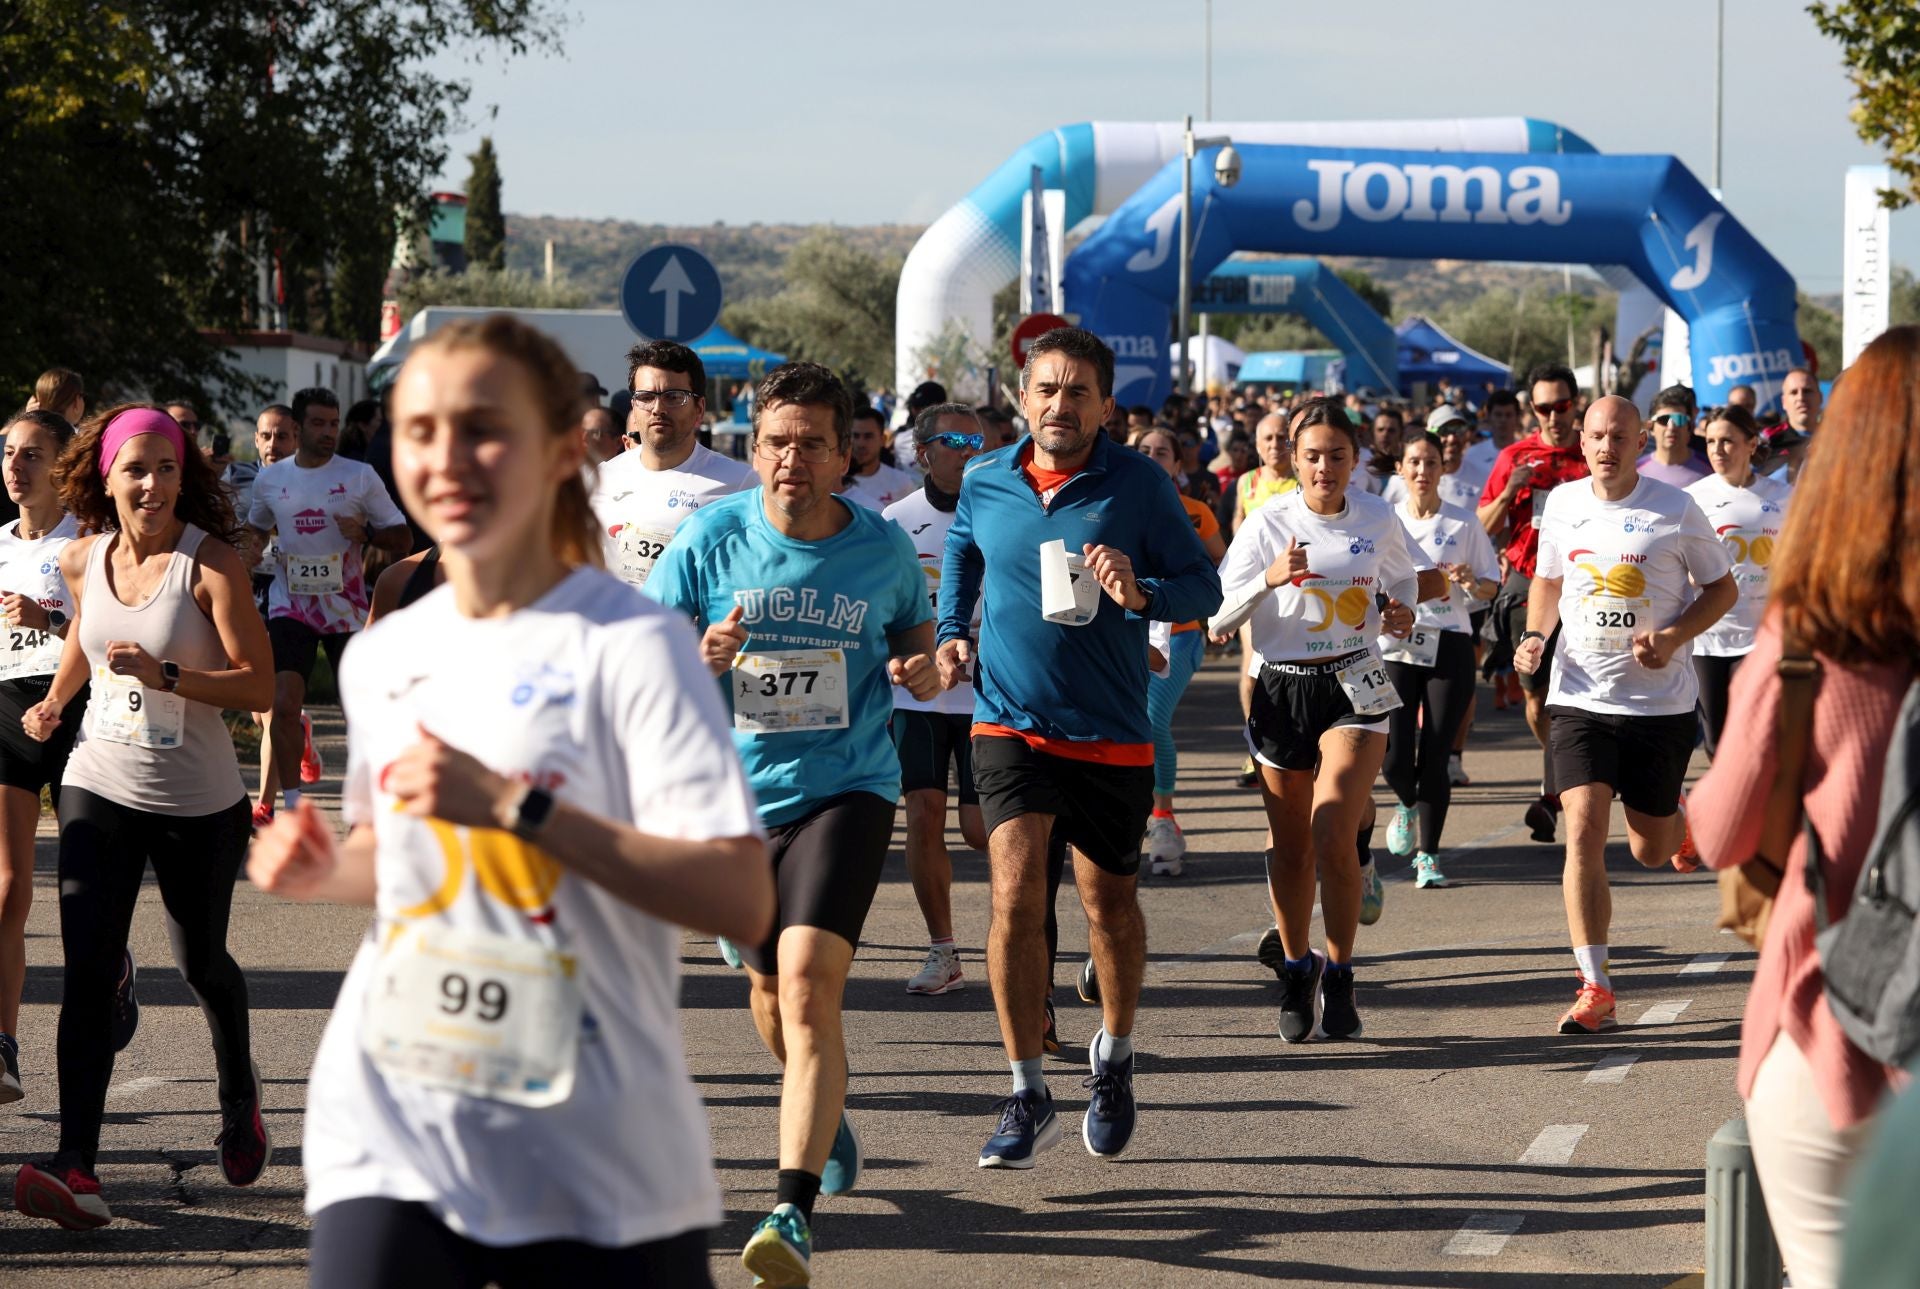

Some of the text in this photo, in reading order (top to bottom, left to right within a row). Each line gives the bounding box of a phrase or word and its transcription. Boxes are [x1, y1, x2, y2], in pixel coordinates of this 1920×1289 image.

[1620, 553, 1647, 563] HNP
[300, 565, 330, 578] 213
[1352, 576, 1373, 586] HNP
[733, 587, 868, 635] UCLM
[1596, 611, 1636, 628] 320
[750, 632, 860, 650] ORTE UNIVERSITARIO
[1305, 641, 1333, 652] 1974
[1343, 636, 1364, 649] 2024
[1269, 663, 1318, 676] MOUR
[760, 671, 819, 697] 377
[128, 691, 142, 712] 9
[441, 972, 510, 1023] 99
